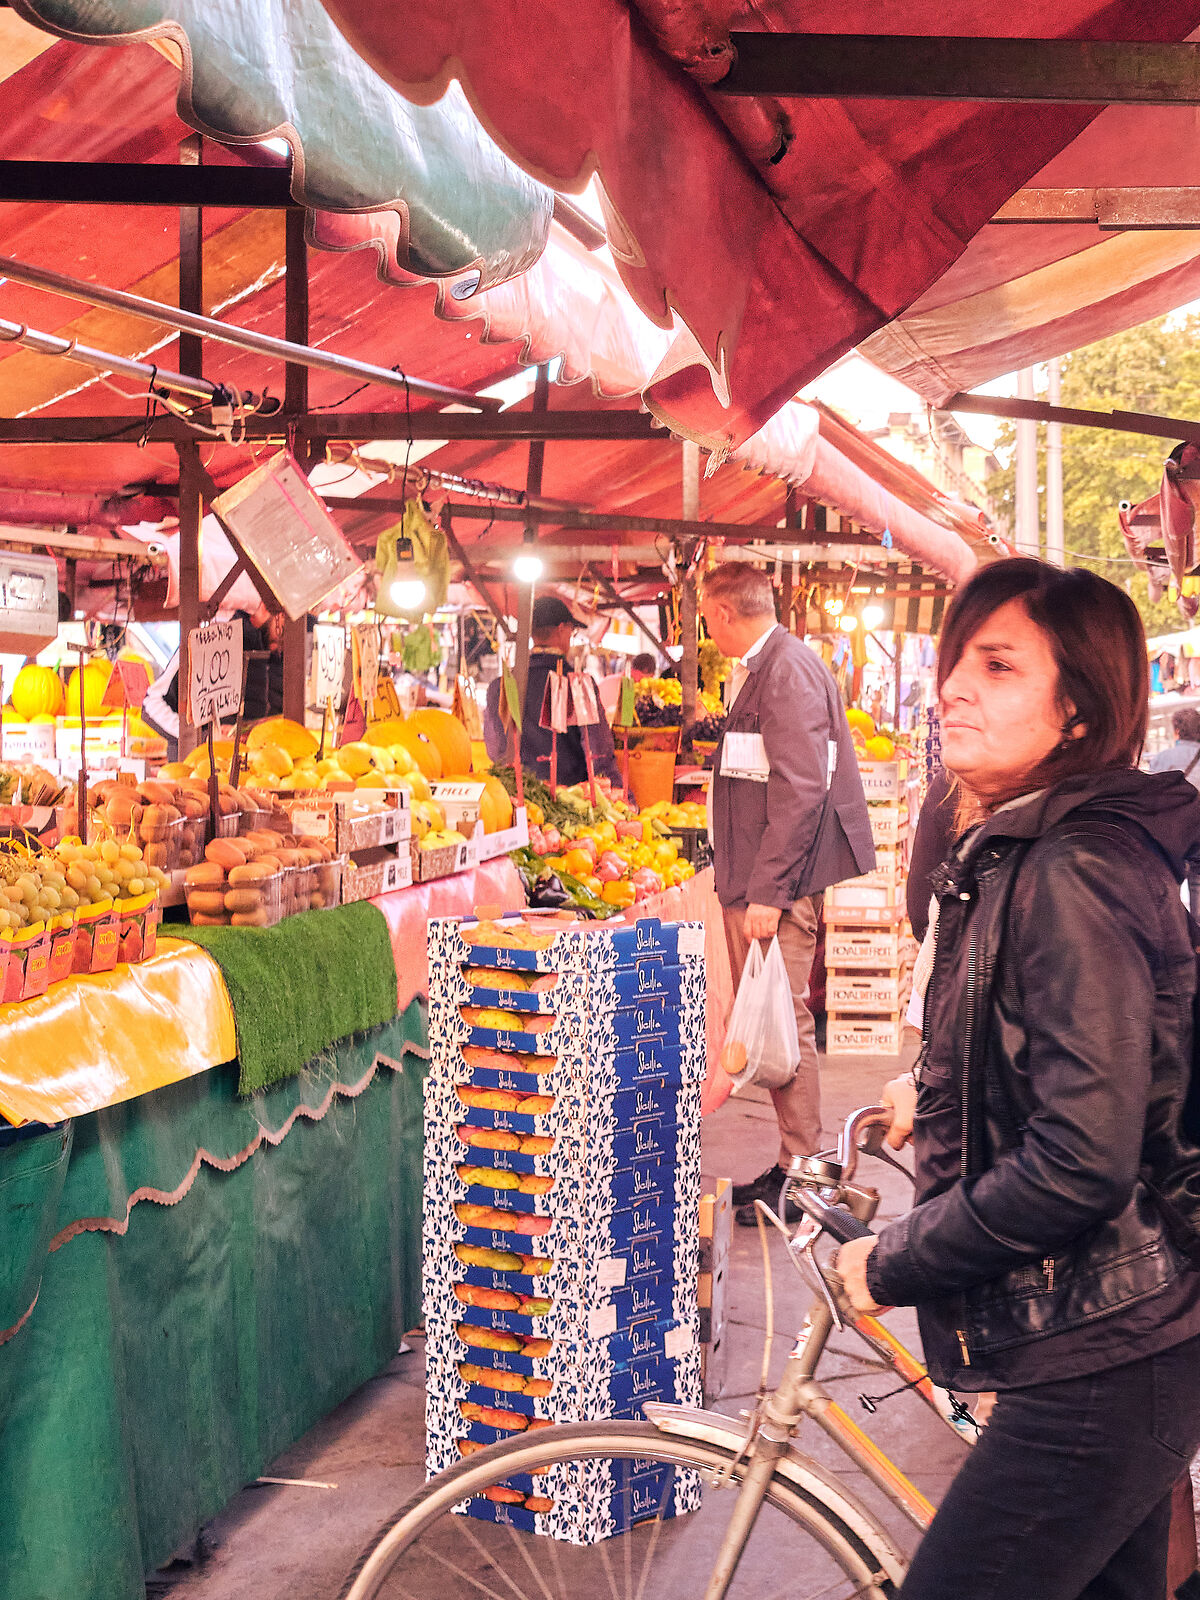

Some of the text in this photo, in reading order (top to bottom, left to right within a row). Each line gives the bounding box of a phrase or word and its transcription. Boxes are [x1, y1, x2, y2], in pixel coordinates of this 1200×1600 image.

[833, 946, 857, 955] ROYAL
[833, 991, 858, 1000] ROYAL
[834, 1034, 858, 1043] ROYAL
